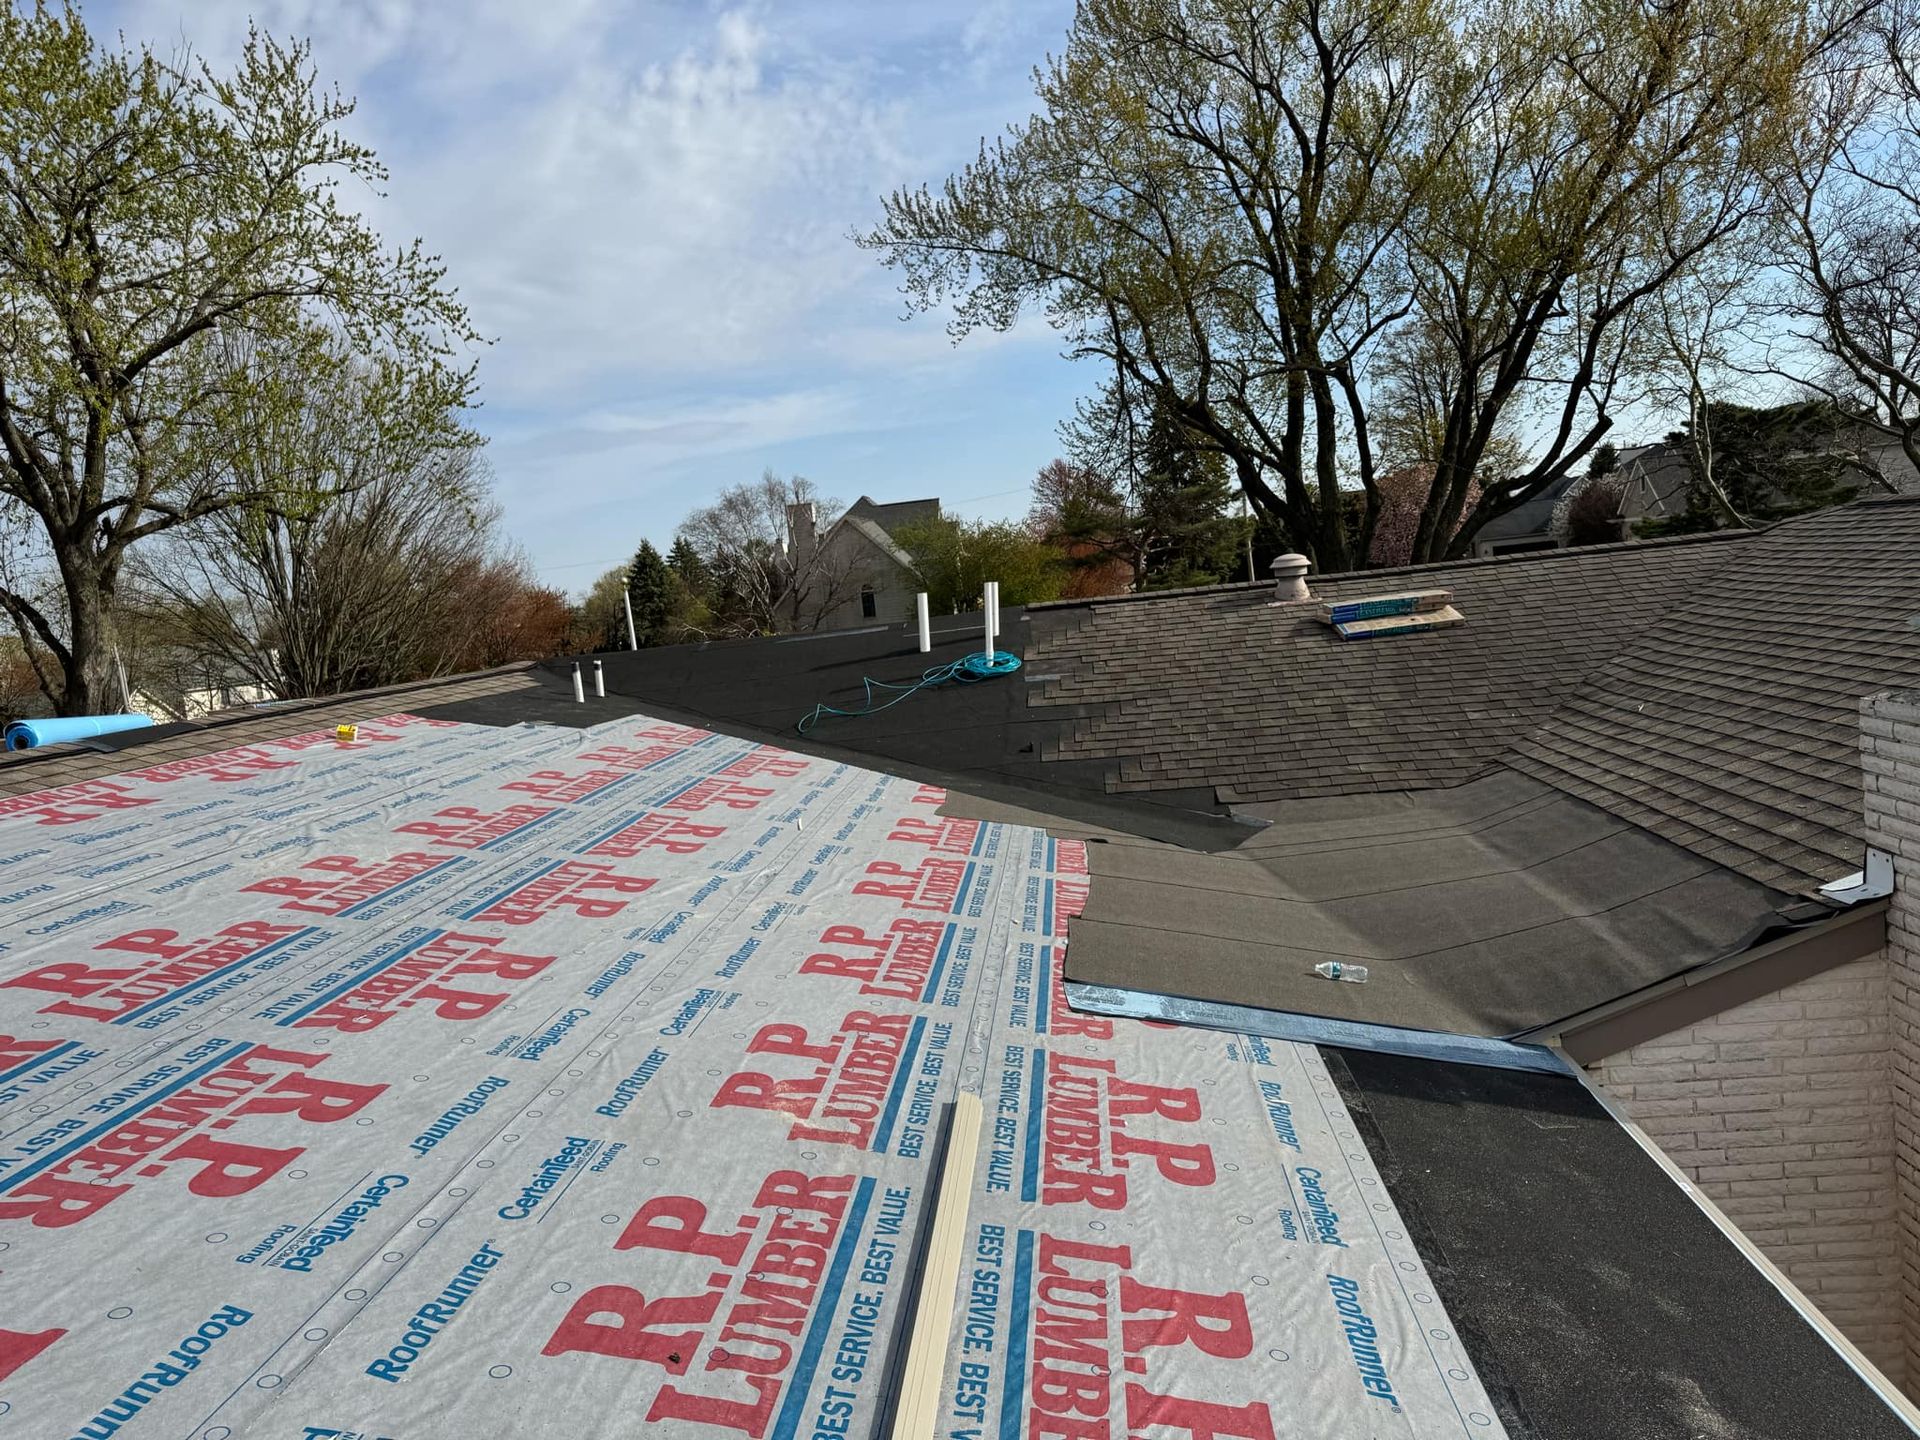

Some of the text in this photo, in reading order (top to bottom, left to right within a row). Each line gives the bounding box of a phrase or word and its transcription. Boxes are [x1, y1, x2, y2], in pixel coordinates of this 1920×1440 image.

[11, 793, 163, 825] R.P.
[497, 771, 592, 794] R.P.
[391, 806, 503, 839] R.P.
[427, 804, 558, 849] LUMBER
[582, 812, 690, 857] LUMBER
[639, 822, 728, 853] R.P.
[147, 861, 235, 894] RoofRunner
[238, 856, 385, 899] R.P.
[277, 852, 460, 915] LUMBER
[352, 901, 391, 921] BEST
[381, 884, 434, 907] SERVICE.
[470, 861, 616, 925] LUMBER
[545, 872, 660, 918] R.P.
[850, 861, 933, 900] R.P.
[901, 857, 967, 914] LUMBER
[25, 900, 128, 935] CertainTeed
[0, 928, 212, 998] R.P.
[36, 920, 309, 1022] LUMBER
[132, 931, 344, 1030] BEST SERVICE. BEST VALUE.
[249, 926, 429, 1019] BEST SERVICE. BEST VALUE.
[292, 931, 507, 1033] LUMBER
[396, 948, 560, 1020] R.P.
[583, 951, 647, 1001] RoofRunner
[714, 936, 762, 979] RoofRunner
[798, 924, 900, 982] R.P.
[858, 918, 945, 1002] LUMBER
[659, 988, 716, 1037] CertainTeed
[941, 989, 961, 1007] BEST
[1011, 986, 1031, 1004] BEST
[22, 1048, 111, 1084] VALUE.
[519, 1008, 593, 1061] CertainTeed
[14, 1038, 233, 1156] BEST SERVICE. BEST
[594, 1047, 671, 1118] RoofRunner
[708, 1023, 847, 1120] R.P.
[786, 1010, 912, 1151] LUMBER
[897, 1022, 954, 1159] BEST SERVICE. BEST VALUE.
[0, 1044, 333, 1227] LUMBER
[136, 1071, 392, 1198] R.P.
[409, 1075, 512, 1156] RoofRunner
[985, 1045, 1025, 1193] BEST SERVICE. BEST VALUE.
[1041, 1050, 1128, 1211] LUMBER
[1106, 1075, 1217, 1187] R.P.
[1257, 1079, 1303, 1154] RoofRunner
[498, 1136, 592, 1221] CertainTeed
[590, 1142, 628, 1173] Roofing
[280, 1174, 410, 1273] CertainTeed
[874, 1186, 912, 1237] VALUE.
[1277, 1208, 1297, 1242] Roofing
[1295, 1166, 1349, 1249] CertainTeed
[236, 1224, 298, 1263] Roofing
[860, 1239, 895, 1285] BEST
[975, 1224, 1006, 1268] BEST
[364, 1243, 505, 1383] RoofRunner
[540, 1195, 761, 1376] R.P.
[645, 1170, 857, 1440] LUMBER
[962, 1269, 1000, 1355] SERVICE.
[831, 1291, 884, 1384] SERVICE.
[1325, 1273, 1398, 1412] RoofRunner
[66, 1304, 256, 1440] RoofRunn
[952, 1361, 990, 1424] BEST
